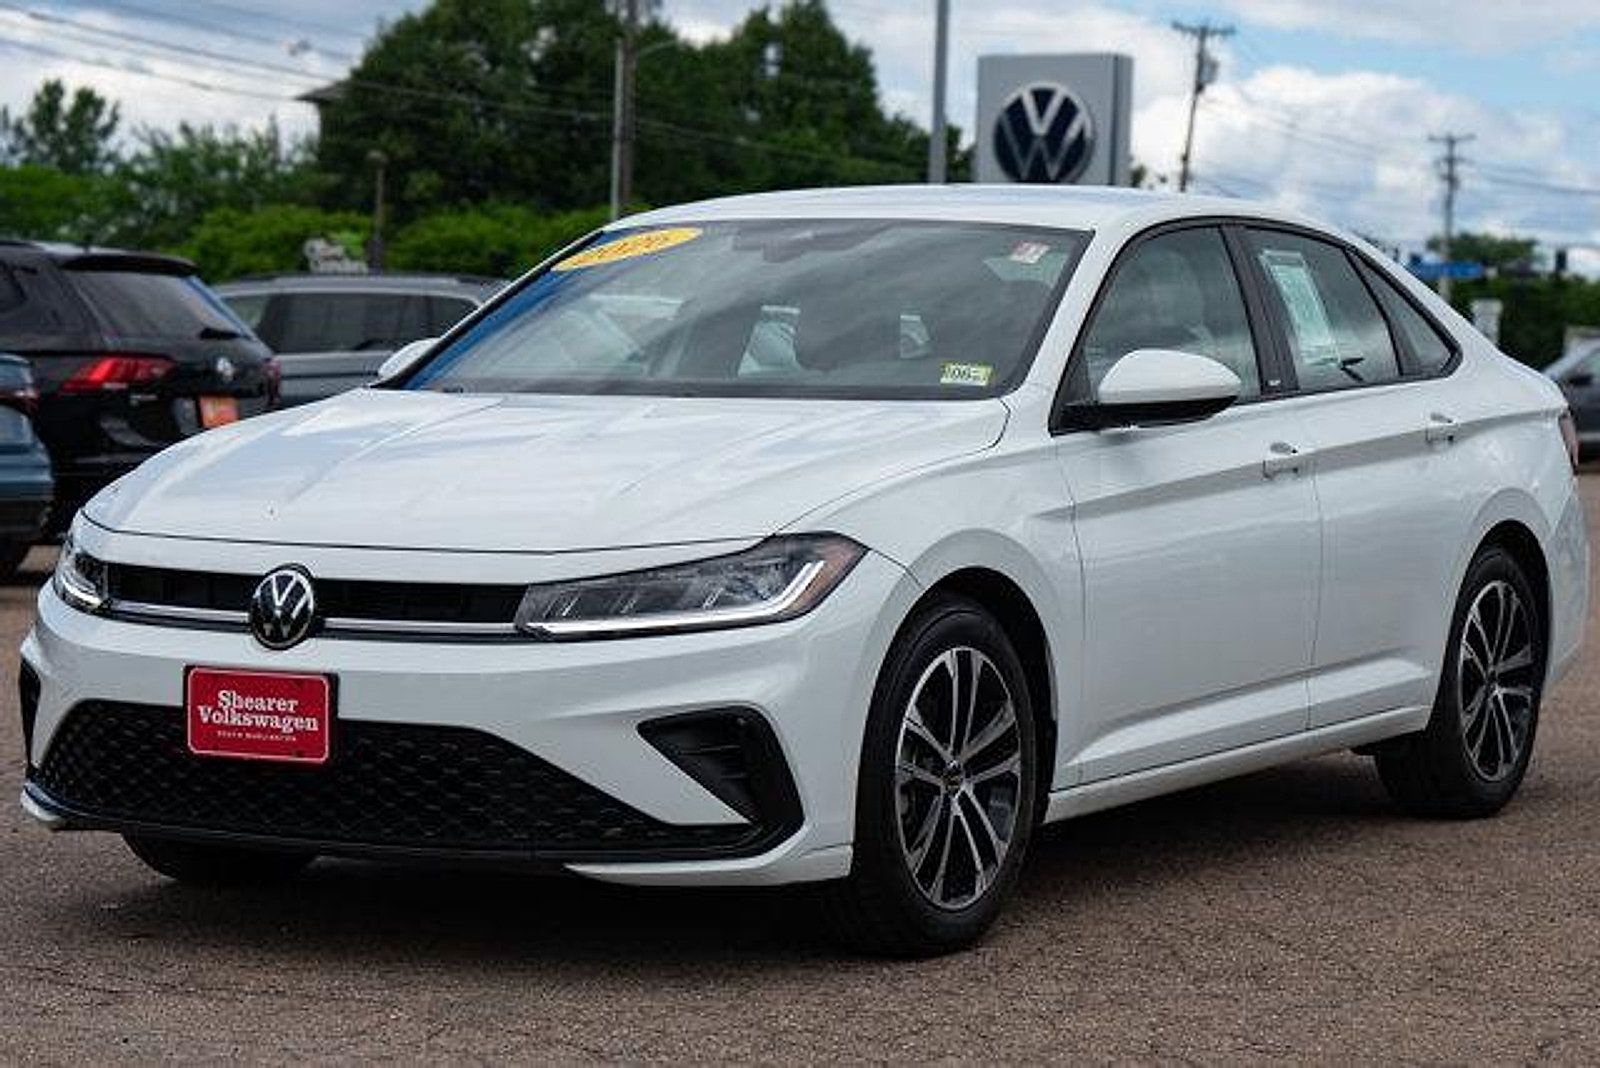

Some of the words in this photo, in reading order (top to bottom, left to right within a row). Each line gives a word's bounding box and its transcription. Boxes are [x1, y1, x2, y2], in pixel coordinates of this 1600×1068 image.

[998, 84, 1088, 183] VW
[217, 690, 299, 713] Shearer
[197, 705, 319, 734] Volkswagen
